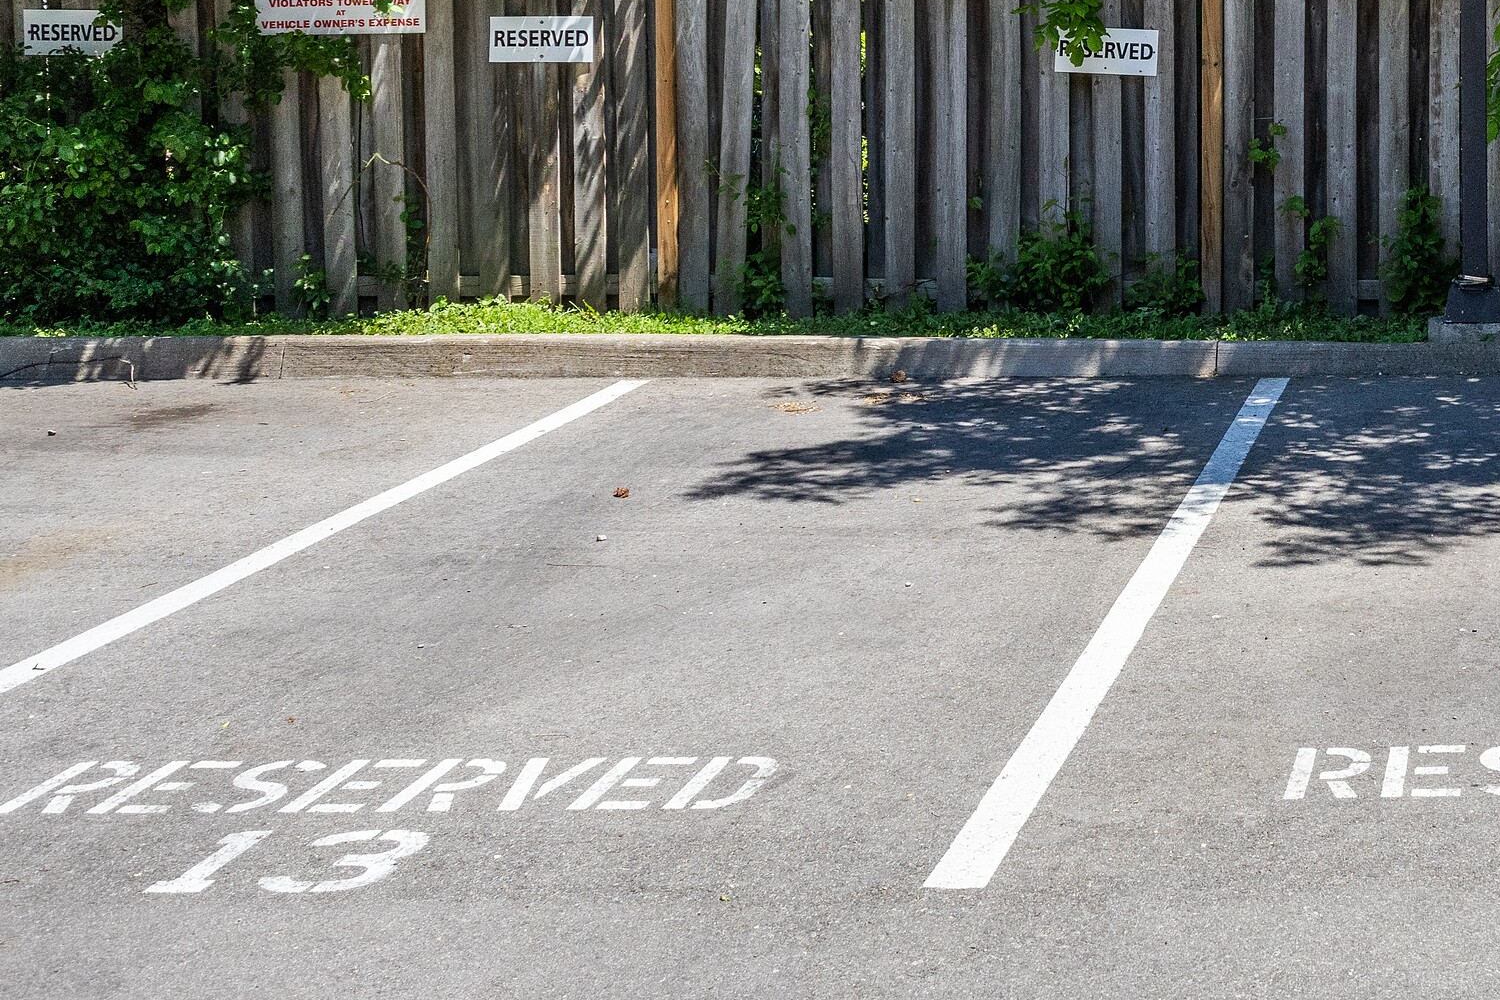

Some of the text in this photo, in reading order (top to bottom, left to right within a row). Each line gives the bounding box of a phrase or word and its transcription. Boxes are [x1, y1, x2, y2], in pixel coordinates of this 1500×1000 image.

[261, 17, 420, 30] VEHICLE OWNER'S EXPENSE
[30, 24, 116, 42] RESERVED
[494, 30, 589, 47] RESERVED
[0, 755, 780, 815] RESERVED
[142, 828, 431, 895] 13
